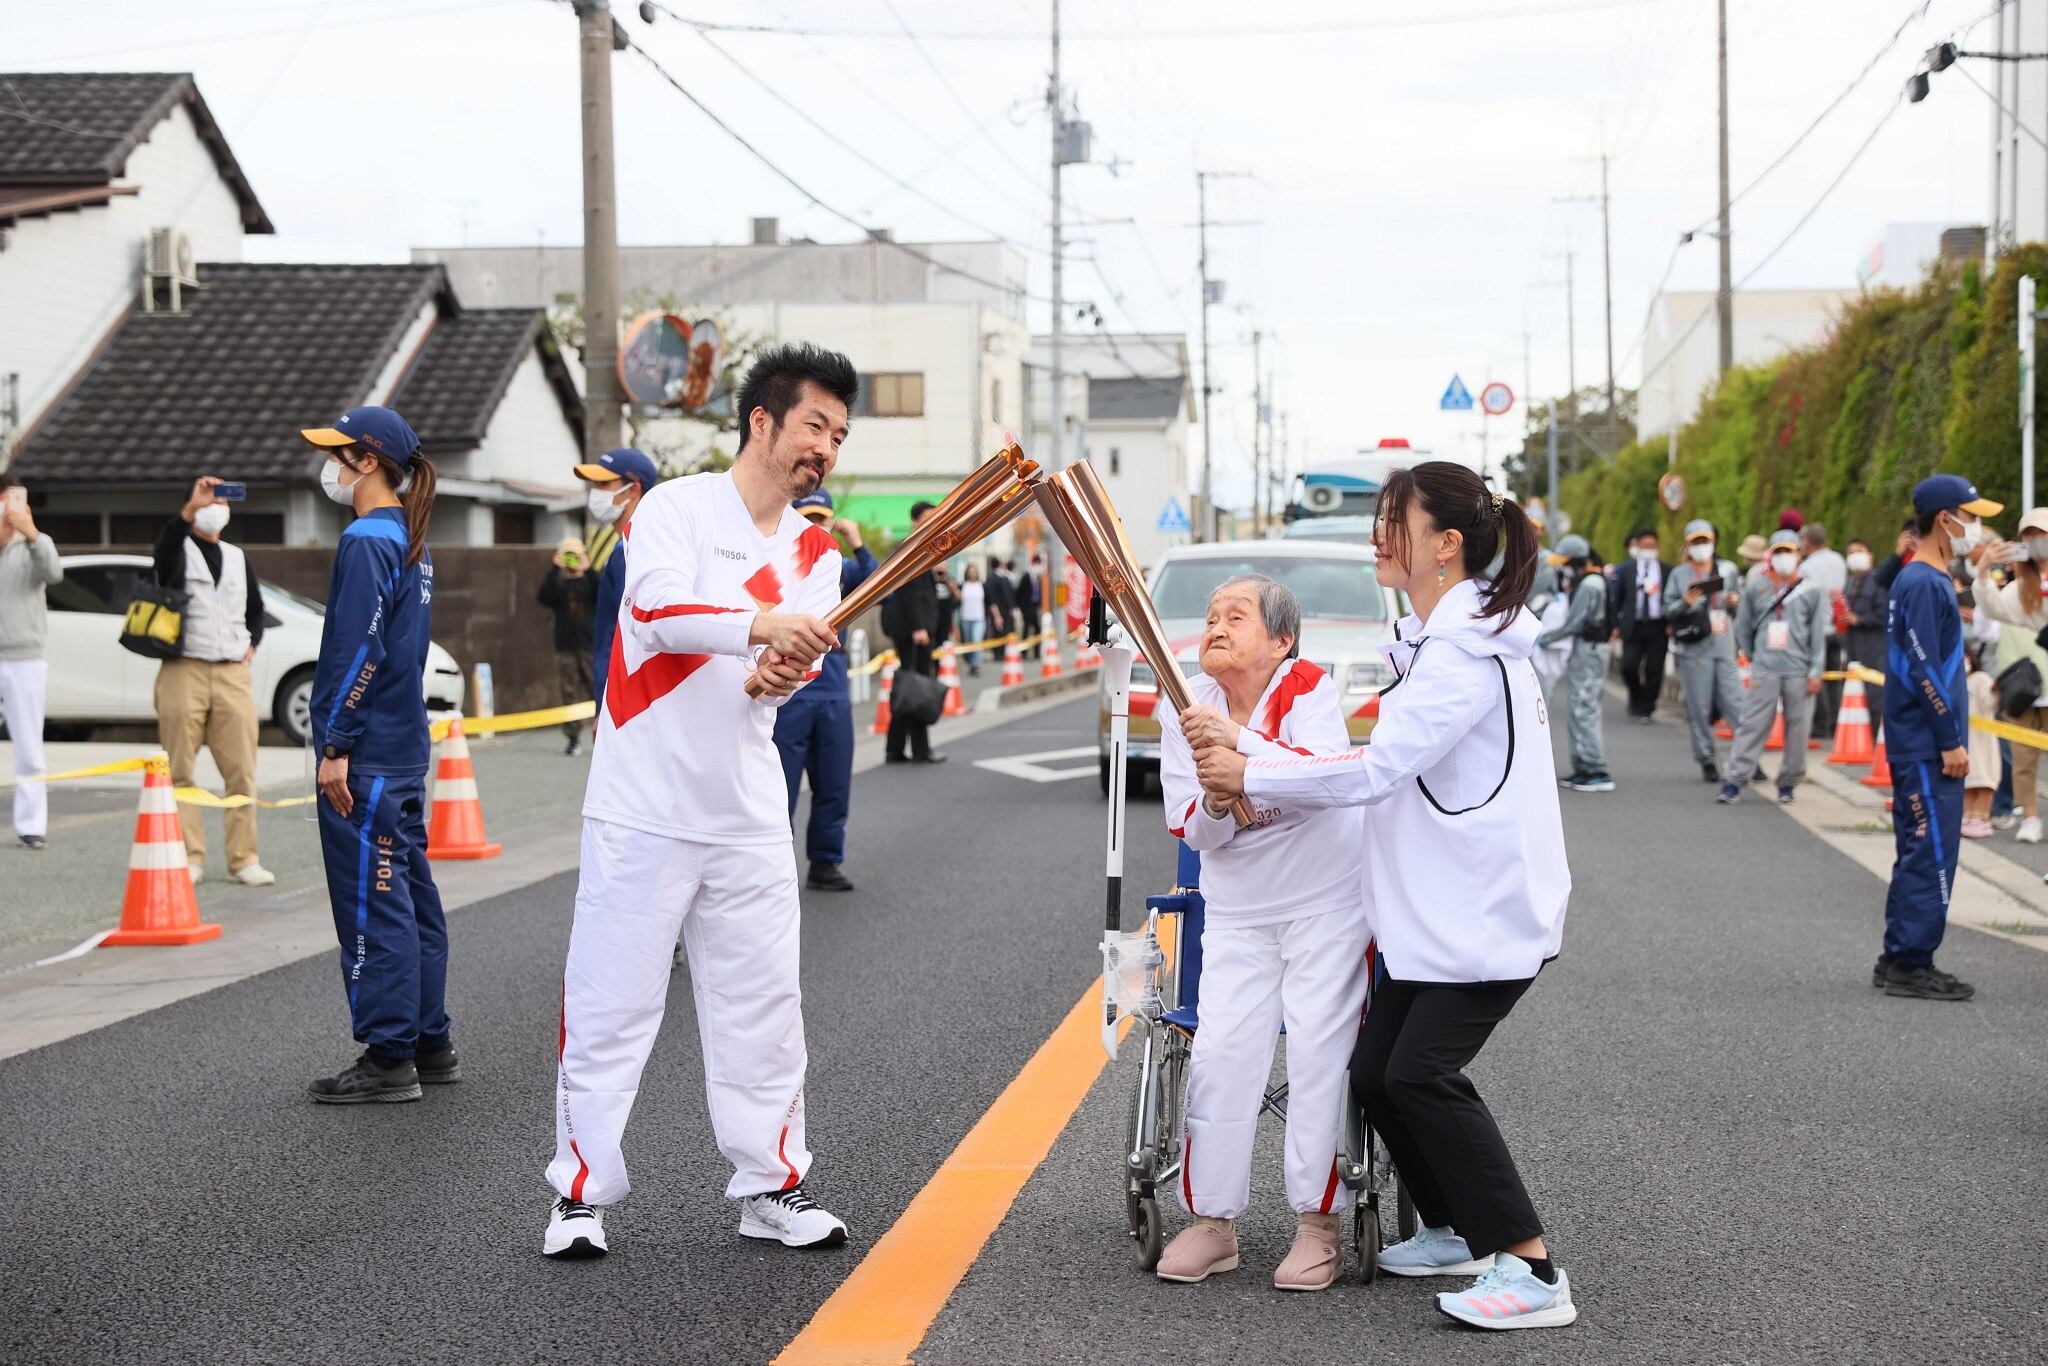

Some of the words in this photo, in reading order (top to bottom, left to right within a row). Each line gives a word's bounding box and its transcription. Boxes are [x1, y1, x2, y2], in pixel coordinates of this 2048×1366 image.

[363, 433, 384, 449] POLICE
[367, 611, 382, 636] TOKYO
[345, 661, 377, 710] POLICE
[1921, 679, 1947, 716] POLICE
[1257, 807, 1282, 821] 020
[376, 835, 393, 892] POLIE
[356, 934, 366, 955] 2020
[564, 1107, 574, 1134] 2020
